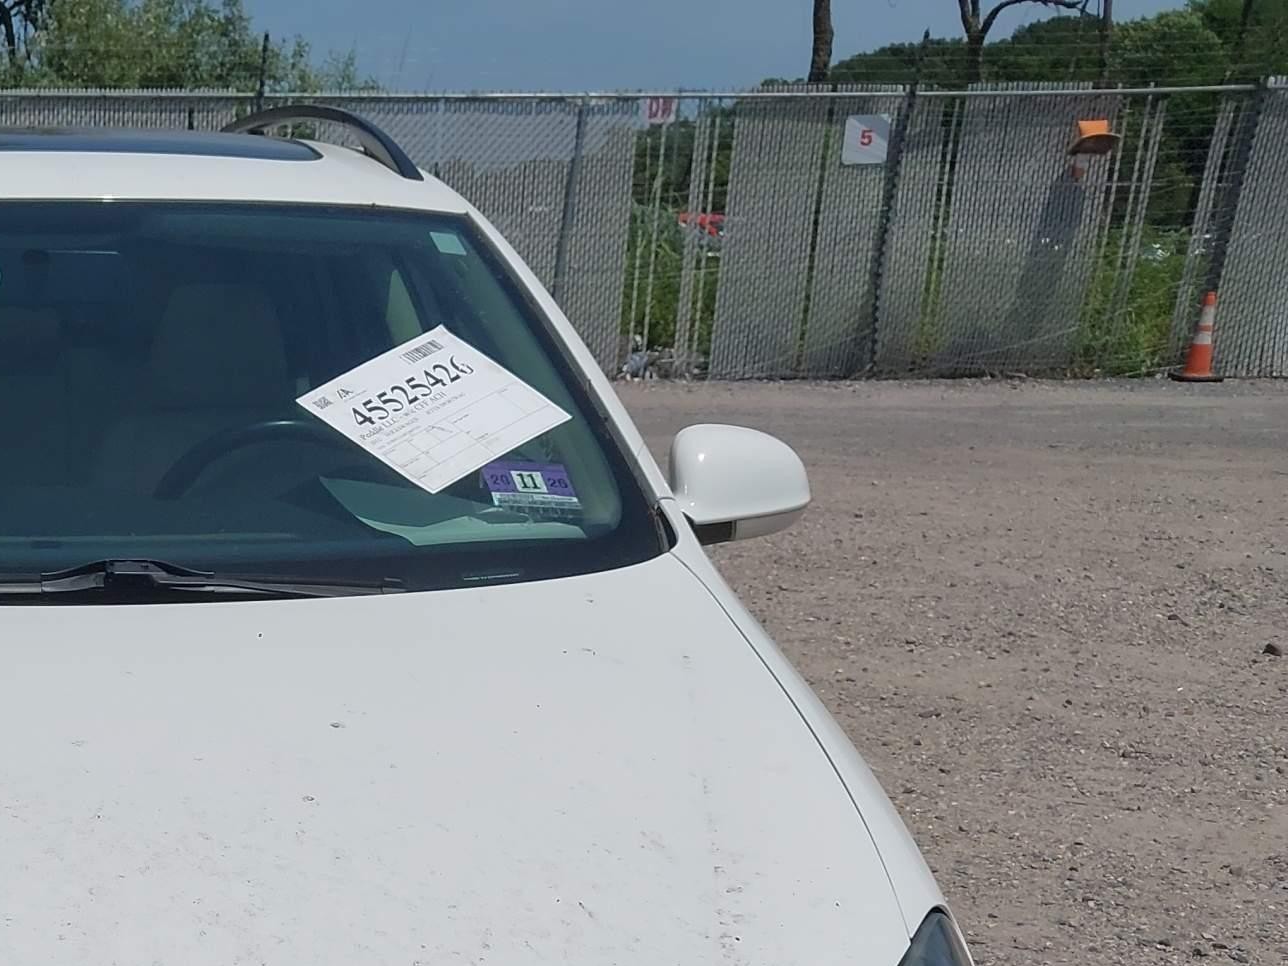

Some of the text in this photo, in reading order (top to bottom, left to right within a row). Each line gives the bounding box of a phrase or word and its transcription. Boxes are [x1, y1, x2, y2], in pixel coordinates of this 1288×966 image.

[860, 129, 874, 147] 5
[352, 355, 474, 425] 45525426
[516, 473, 541, 490] 11
